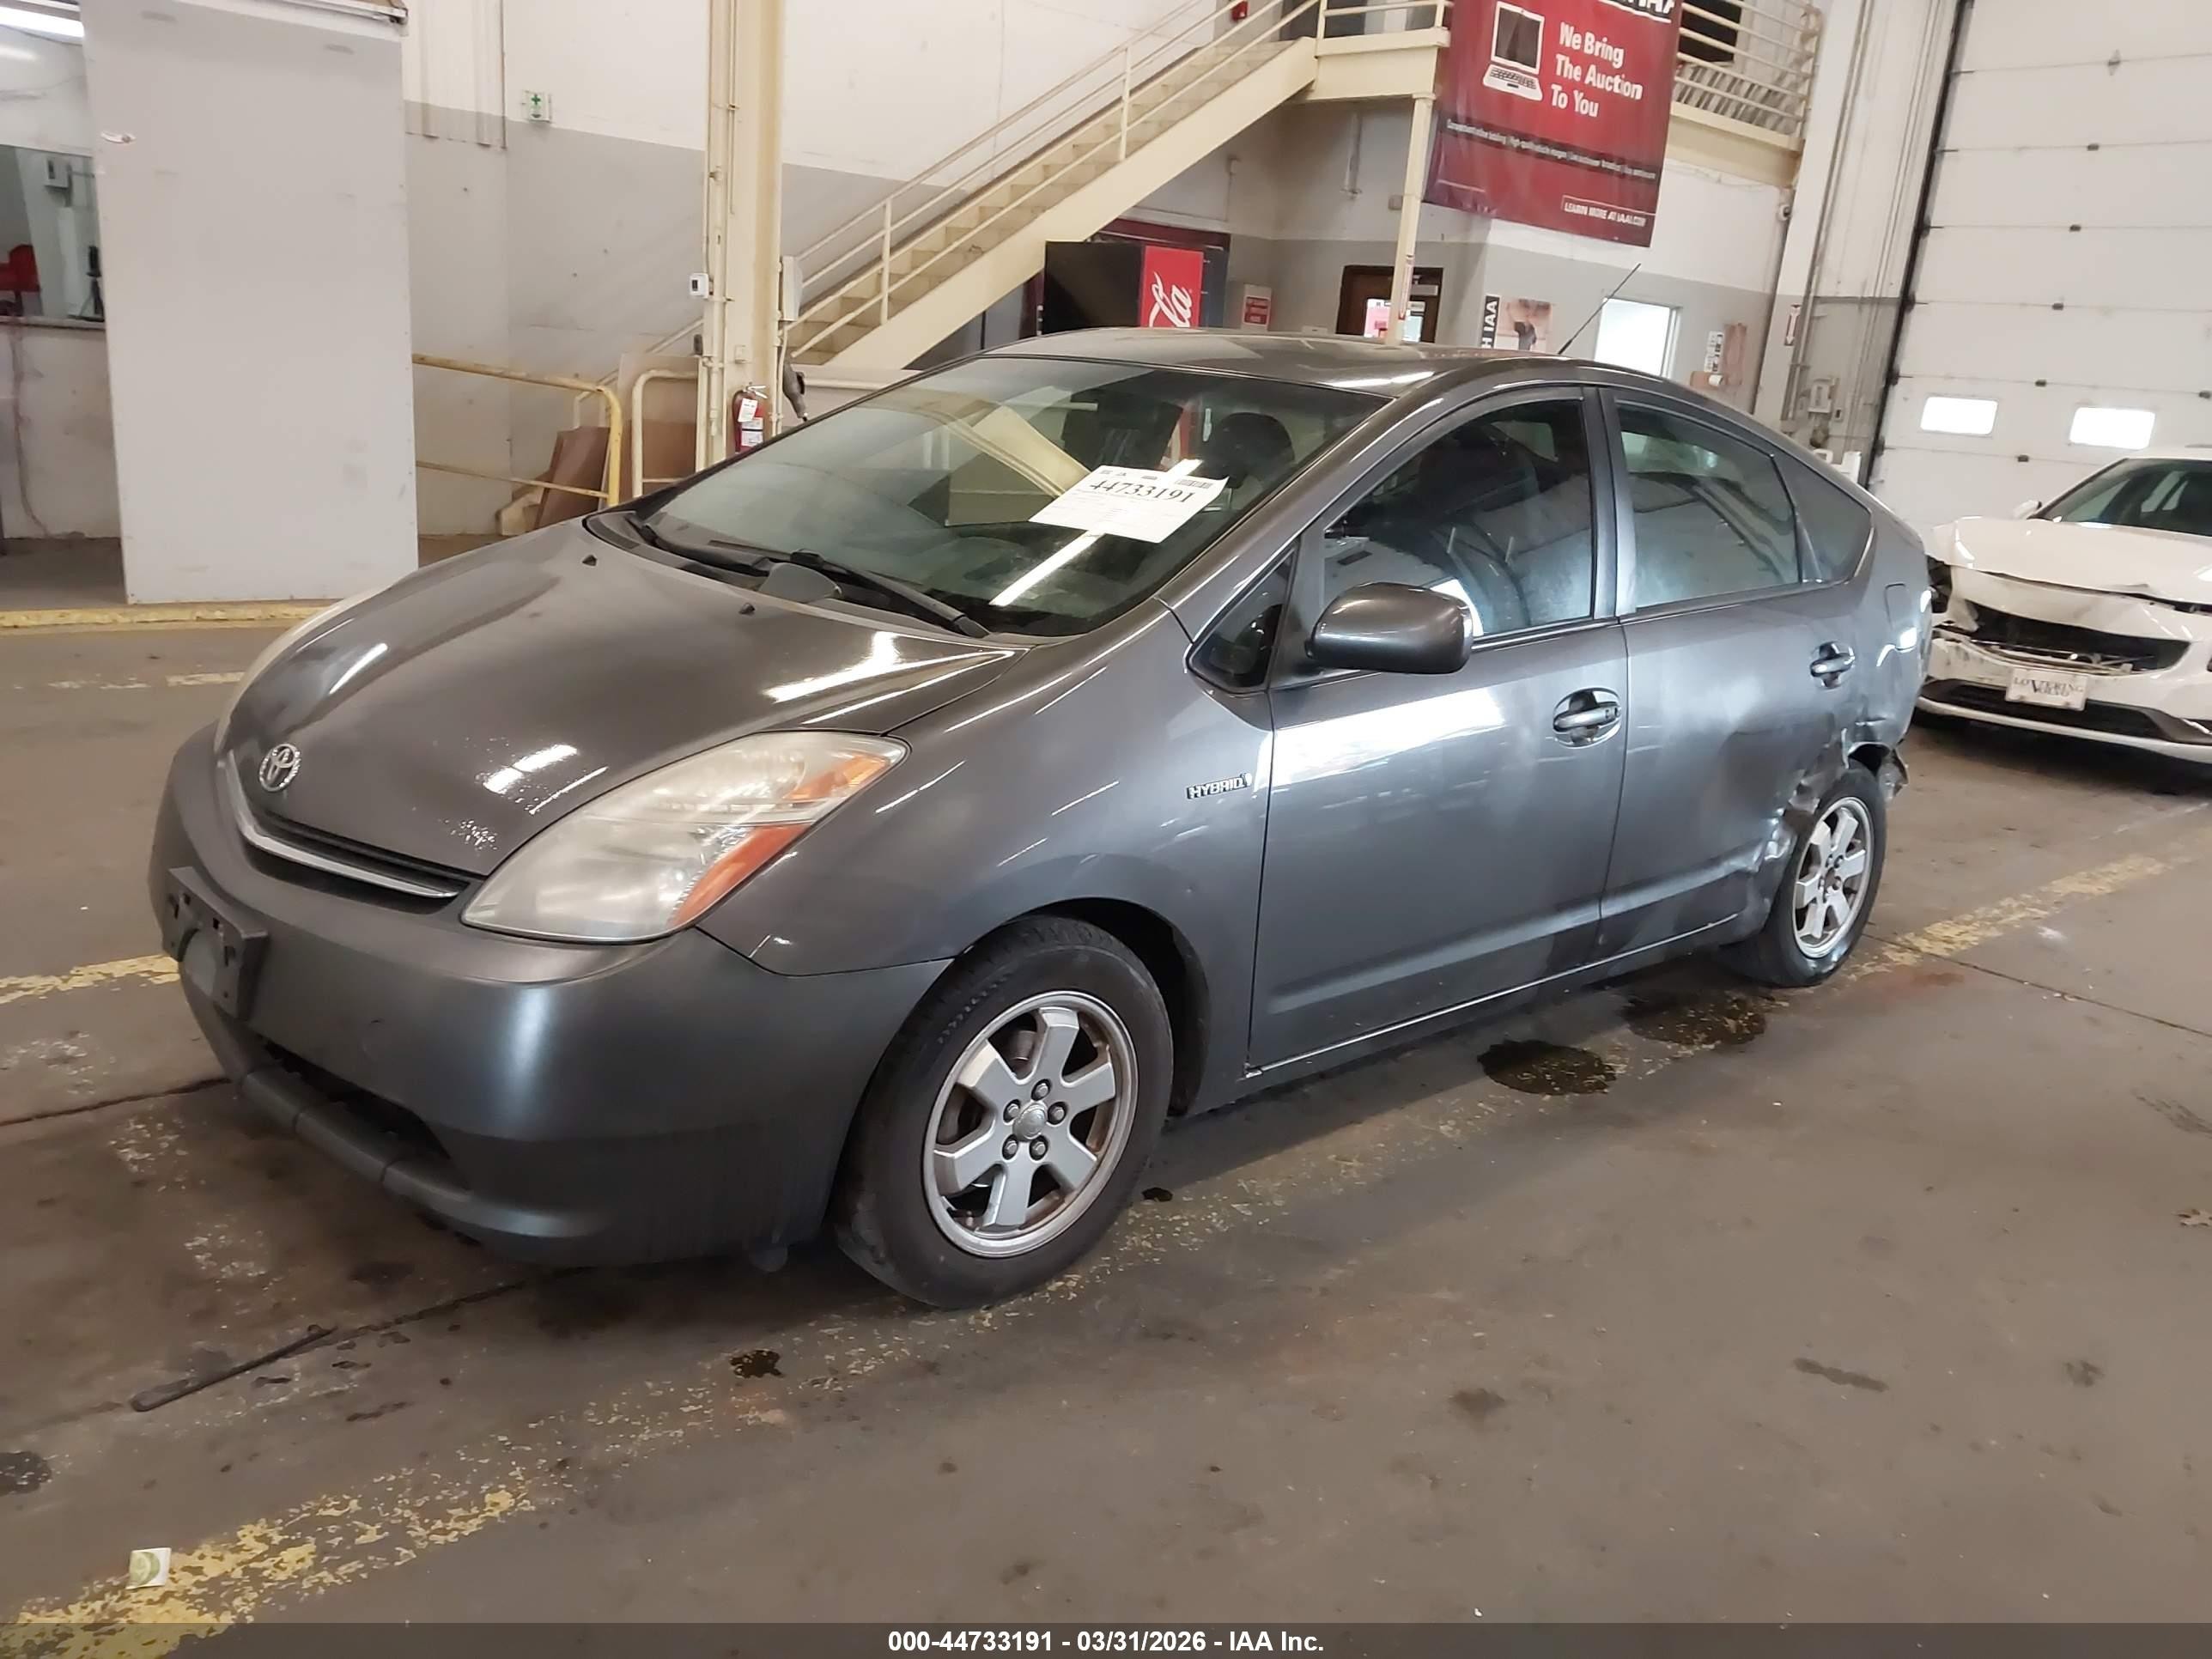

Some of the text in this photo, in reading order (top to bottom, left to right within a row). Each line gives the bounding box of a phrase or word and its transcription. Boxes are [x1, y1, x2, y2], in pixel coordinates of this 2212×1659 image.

[1583, 31, 1625, 69] Bring
[1555, 53, 1644, 100] The Auction
[1551, 83, 1599, 118] To You
[1483, 301, 1498, 331] IAA
[1090, 480, 1196, 502] 44733191
[1187, 776, 1245, 799] HYBRID
